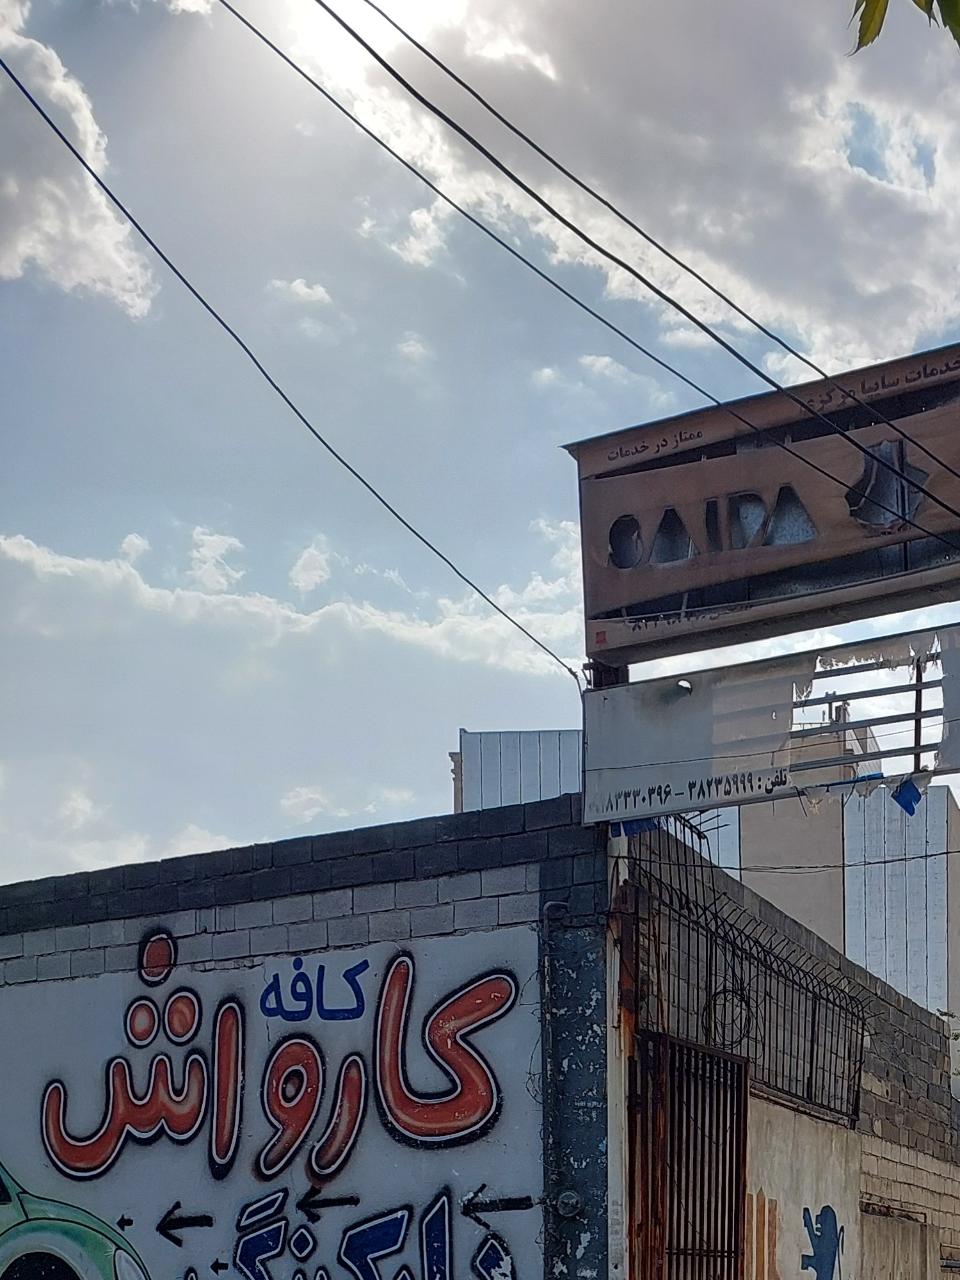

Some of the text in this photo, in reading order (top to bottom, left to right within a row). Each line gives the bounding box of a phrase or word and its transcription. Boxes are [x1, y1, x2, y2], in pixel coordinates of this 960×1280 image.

[607, 430, 703, 461] ممتاز در خدمات
[260, 957, 369, 1023] کافه
[42, 929, 518, 1180] کارواش
